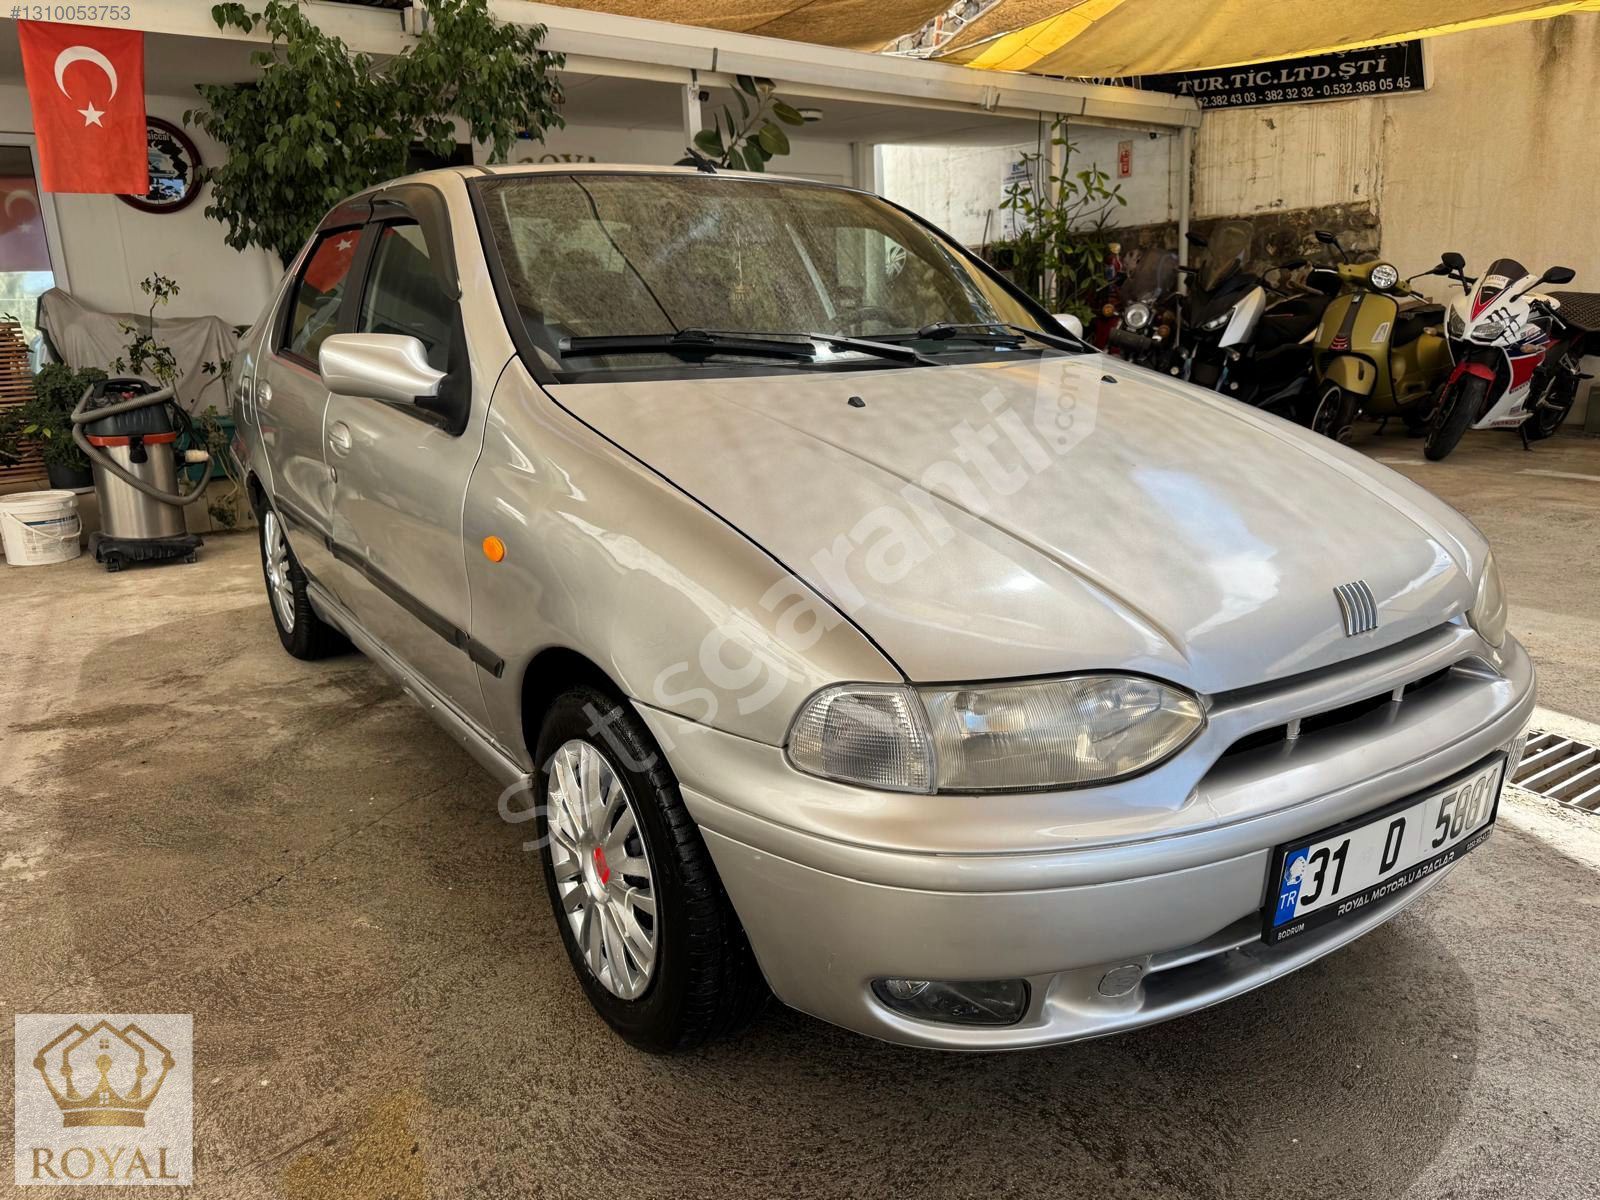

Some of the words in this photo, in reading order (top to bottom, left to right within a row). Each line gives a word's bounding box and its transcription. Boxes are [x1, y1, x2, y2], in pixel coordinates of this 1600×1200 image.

[1230, 93, 1243, 105] 43
[1244, 91, 1257, 103] 03
[1265, 89, 1284, 101] 382
[1286, 88, 1299, 99] 32
[1301, 86, 1314, 98] 32
[1323, 81, 1376, 96] 0.532.368
[1379, 78, 1393, 90] 05
[1396, 76, 1411, 89] 45
[1300, 838, 1350, 906] 31
[1378, 817, 1406, 876] D
[1280, 889, 1297, 910] TR
[1338, 895, 1370, 916] ROYAL
[1370, 871, 1415, 902] MOTORLU
[1278, 922, 1305, 941] BODRUM
